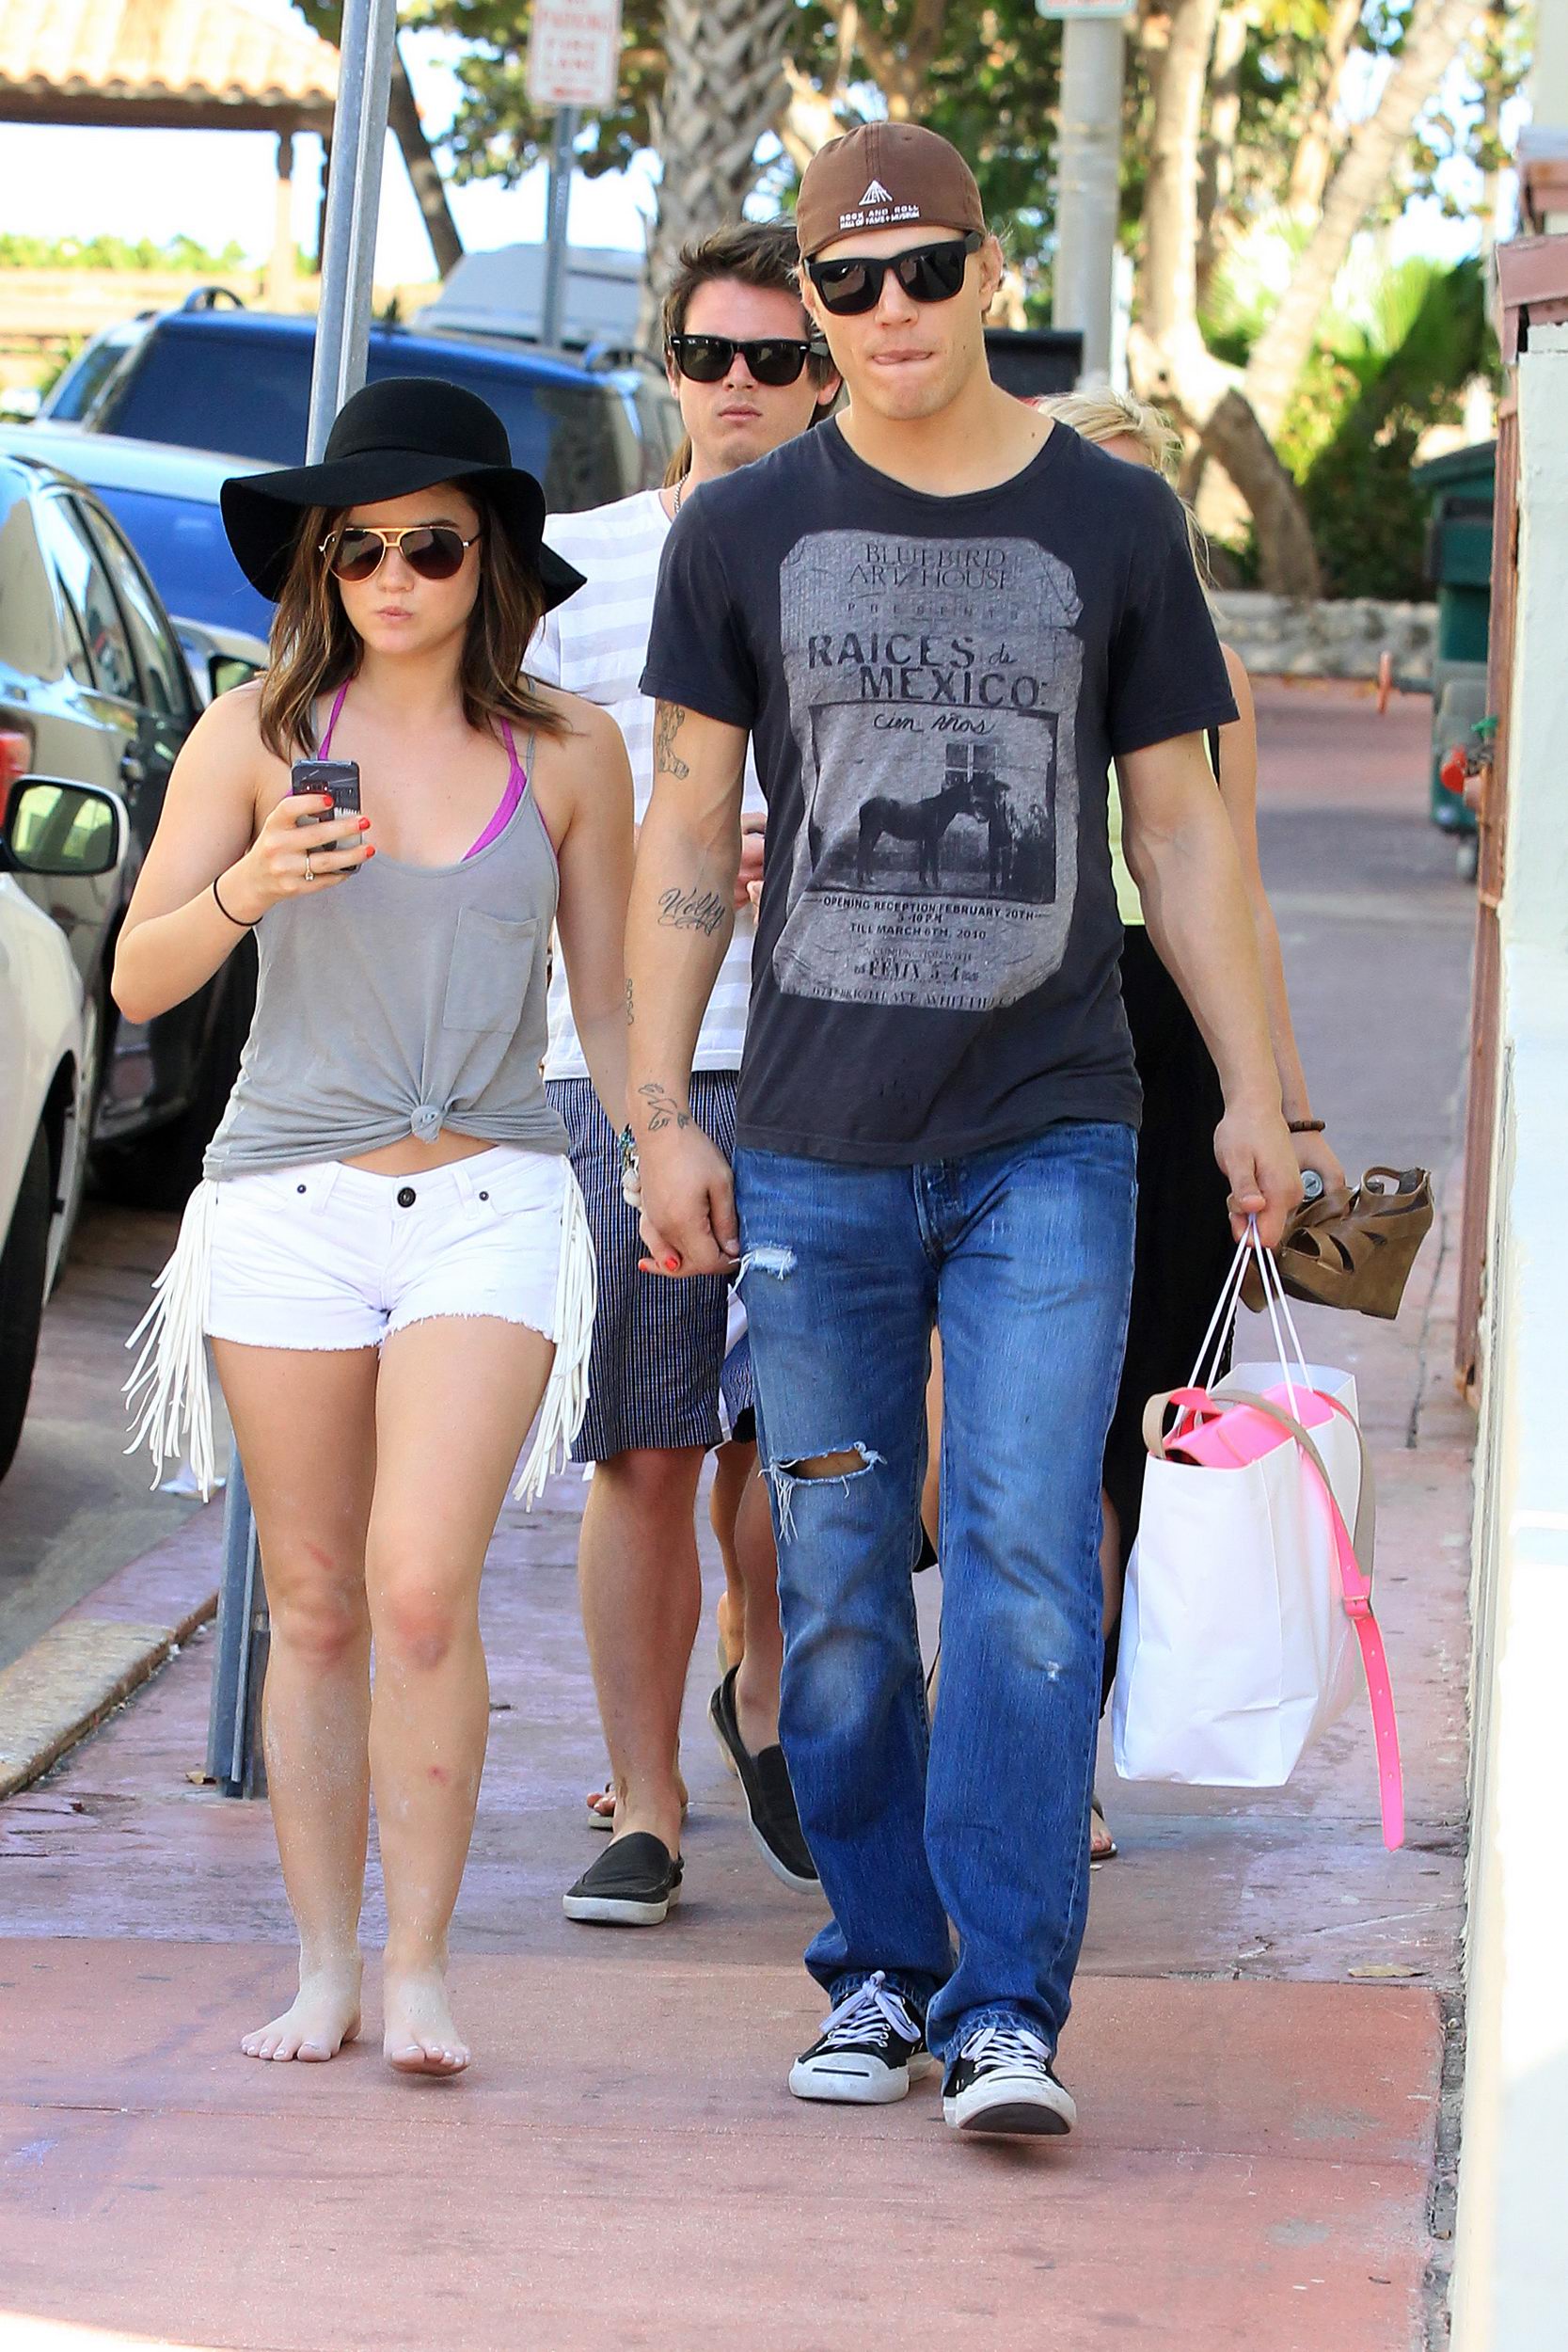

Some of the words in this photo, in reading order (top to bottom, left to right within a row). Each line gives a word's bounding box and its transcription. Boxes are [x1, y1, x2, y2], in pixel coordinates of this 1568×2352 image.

[840, 212, 864, 222] ROCK
[868, 208, 889, 217] AND
[866, 543, 1006, 568] BLUEBIRD
[808, 632, 975, 669] RAICES
[873, 712, 924, 733] cien
[823, 895, 870, 911] OPENING
[874, 900, 936, 914] RECEPTION
[938, 903, 1001, 917] FEBRUARY
[850, 922, 873, 934] TILL
[876, 924, 922, 936] MARCH
[957, 928, 987, 940] 2010
